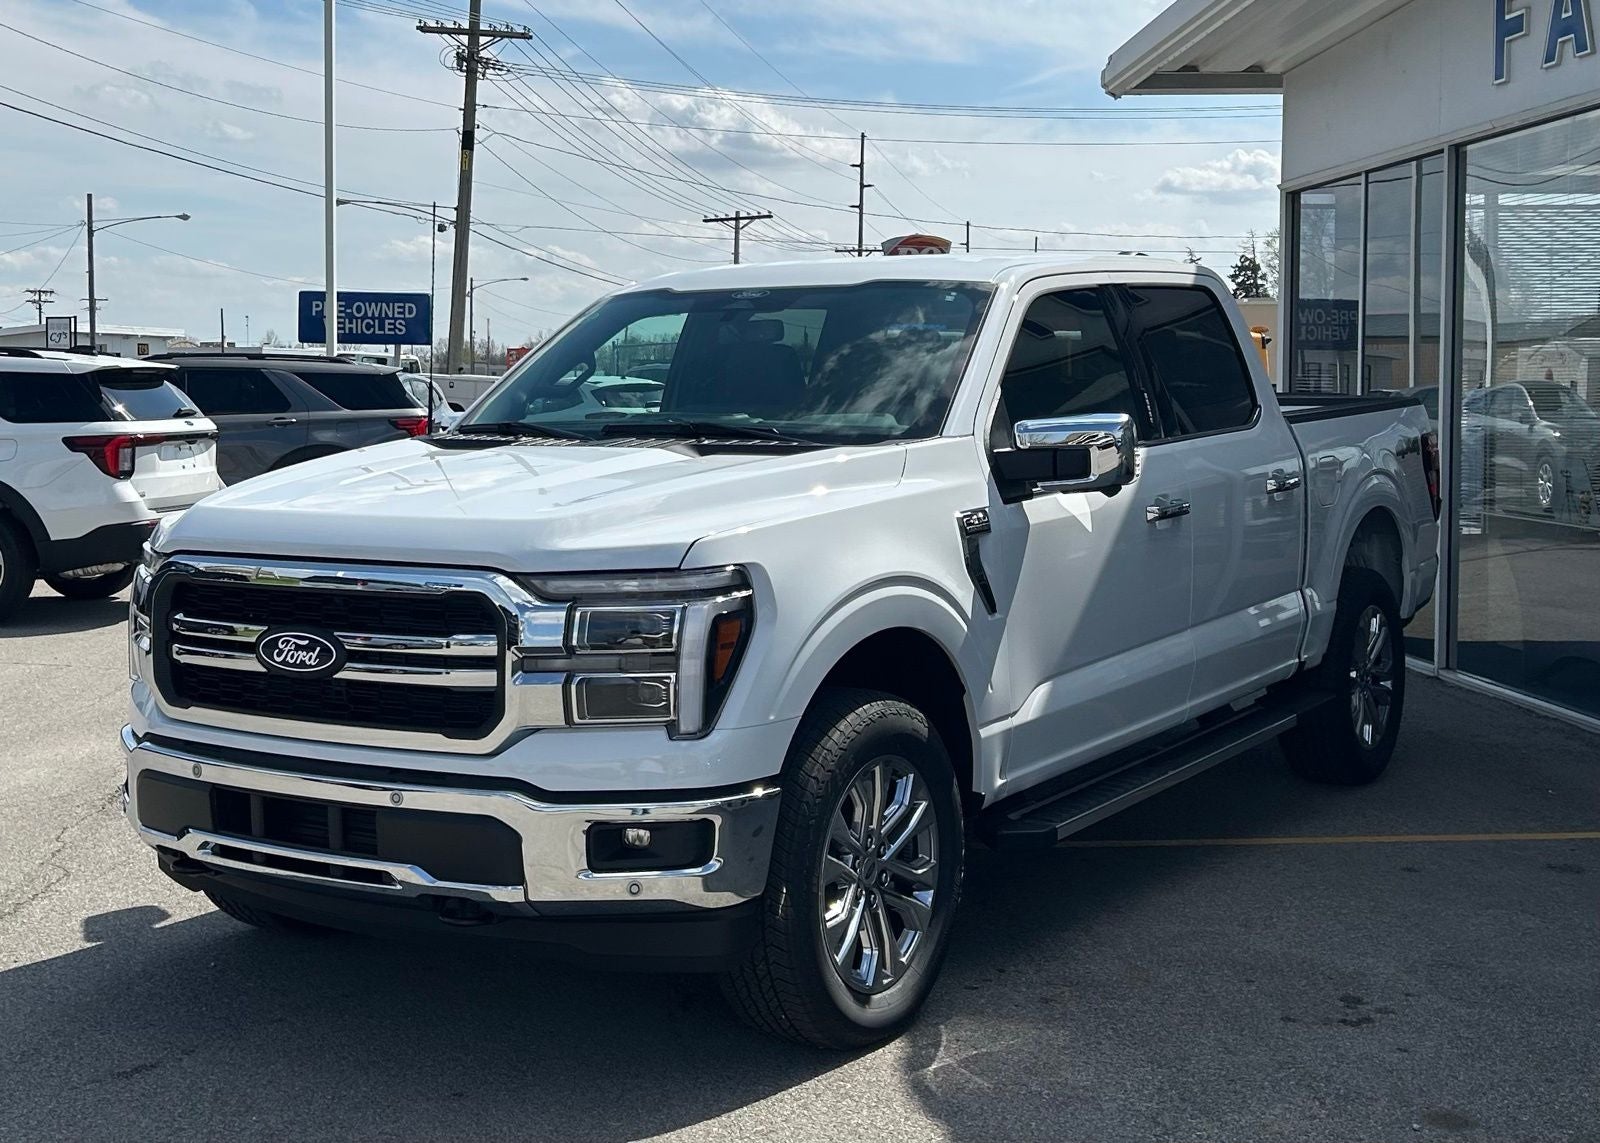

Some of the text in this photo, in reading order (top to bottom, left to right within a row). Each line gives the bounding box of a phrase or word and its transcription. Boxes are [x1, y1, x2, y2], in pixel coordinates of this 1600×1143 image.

[312, 301, 417, 318] PE-OWNED
[323, 318, 407, 335] EHICLES
[273, 636, 321, 666] Ford
